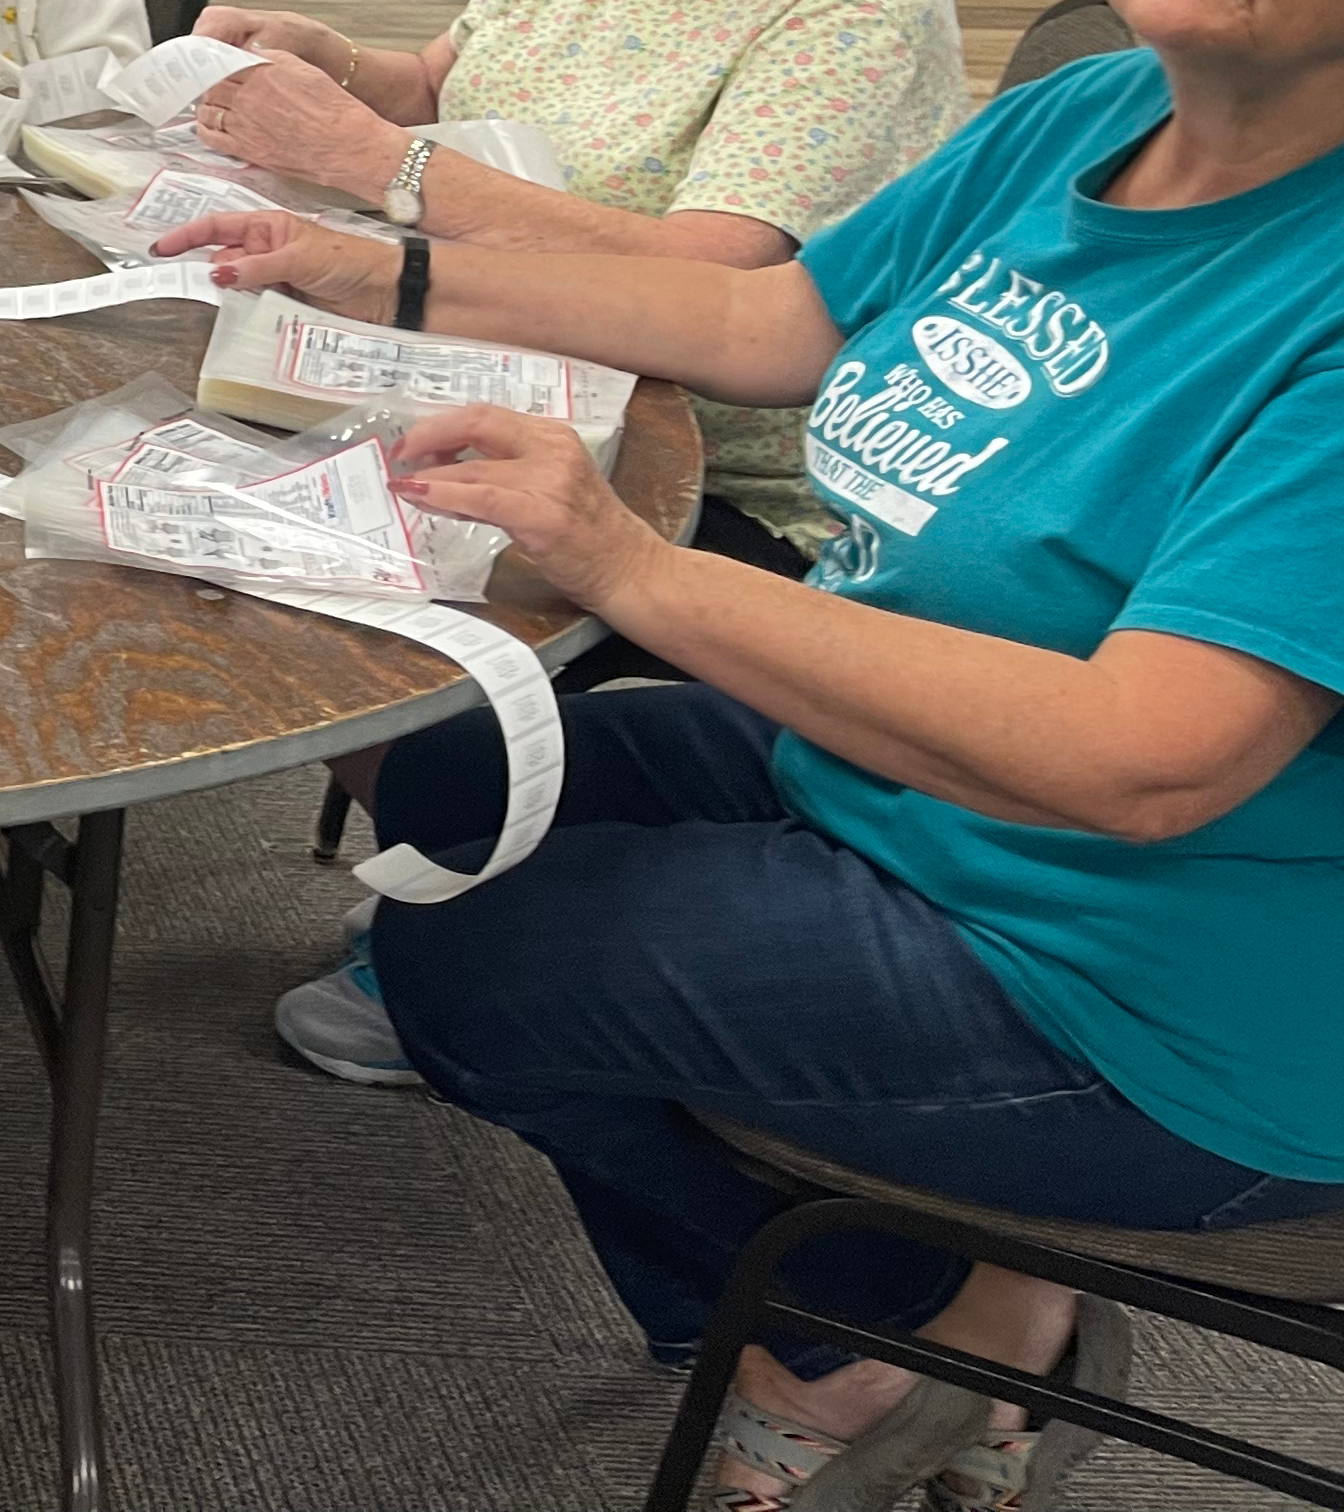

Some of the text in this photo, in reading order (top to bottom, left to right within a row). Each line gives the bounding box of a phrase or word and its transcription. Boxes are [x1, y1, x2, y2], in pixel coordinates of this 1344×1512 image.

[808, 360, 1010, 496] Believed
[884, 363, 966, 429] WHO HAS
